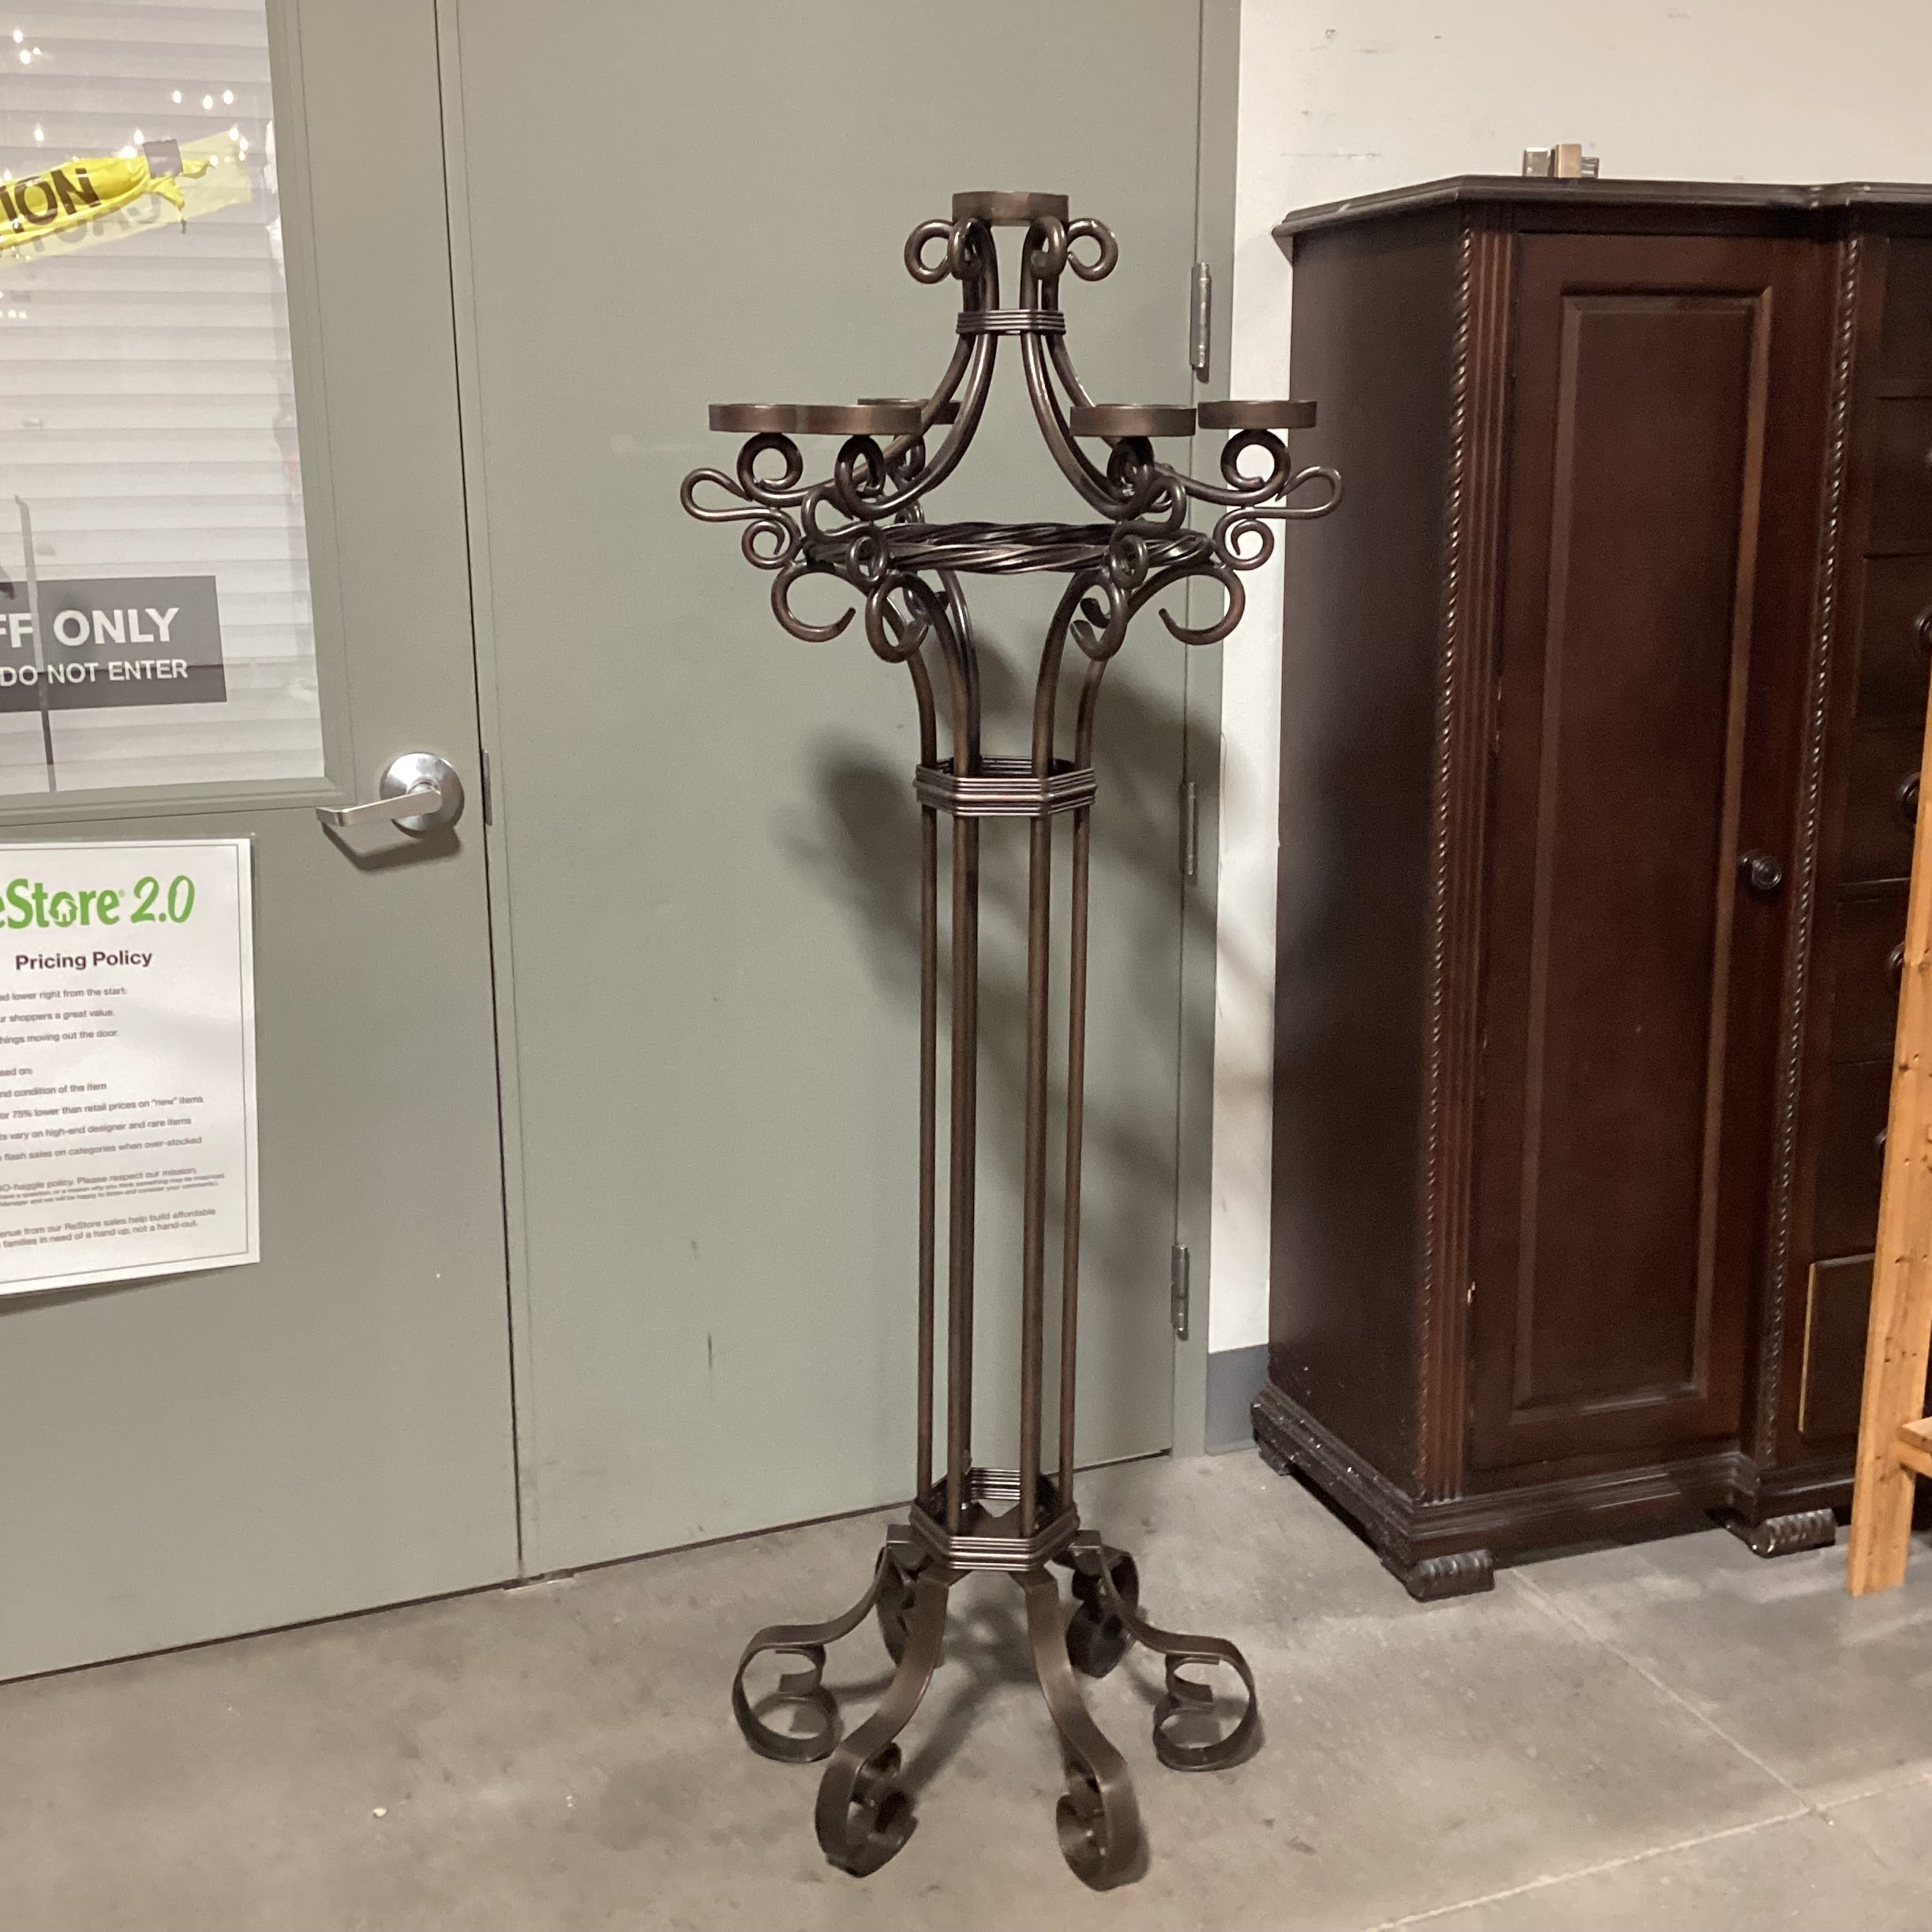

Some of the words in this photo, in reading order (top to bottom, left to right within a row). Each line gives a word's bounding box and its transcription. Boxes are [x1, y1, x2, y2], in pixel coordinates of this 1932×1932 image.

[54, 608, 179, 646] ONLY
[0, 665, 38, 687] DO
[47, 662, 99, 684] NOT
[109, 659, 189, 682] ENTER
[0, 878, 119, 929] Store
[131, 875, 195, 923] 2.0
[16, 953, 87, 971] Pricing
[92, 949, 152, 968] Policy
[39, 990, 61, 1000] right
[63, 989, 84, 998] from
[9, 1013, 53, 1023] shoppers
[63, 1010, 87, 1020] great
[27, 1033, 60, 1043] moving
[14, 1087, 56, 1097] condition
[58, 1084, 68, 1093] of
[69, 1084, 84, 1092] the
[87, 1082, 107, 1091] item
[34, 1108, 59, 1117] lower
[62, 1106, 82, 1114] than
[84, 1103, 107, 1113] retail
[109, 1101, 137, 1111] prices
[179, 1095, 204, 1104] items
[10, 1132, 29, 1140] vary
[87, 1124, 126, 1133] designer
[129, 1121, 145, 1129] and
